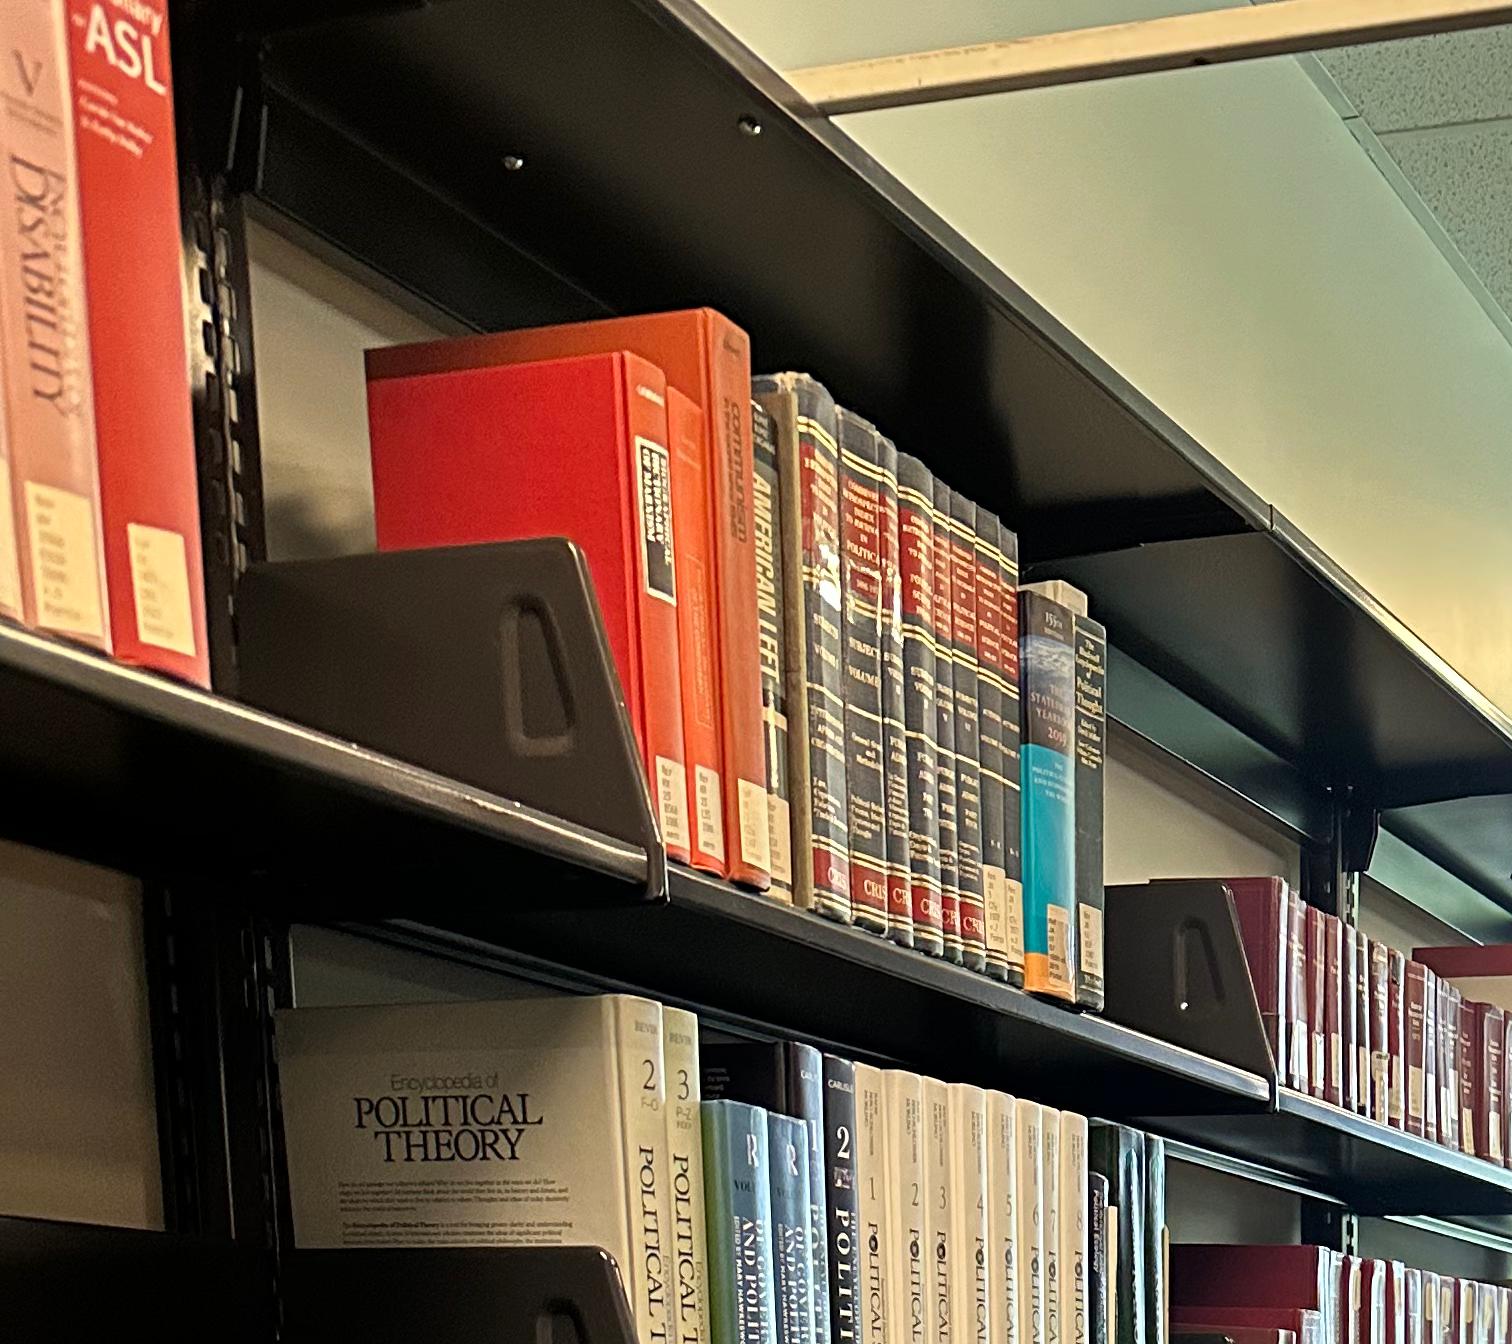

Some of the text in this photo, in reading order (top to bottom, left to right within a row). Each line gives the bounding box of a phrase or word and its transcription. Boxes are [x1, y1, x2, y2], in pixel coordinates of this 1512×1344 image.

[84, 3, 168, 96] ASL
[11, 153, 70, 418] DISABILITY
[753, 471, 780, 683] AMERICAN LEFT
[863, 878, 888, 900] CRIS
[391, 1072, 499, 1094] Encyclopedia of
[642, 1059, 657, 1092] 2
[677, 1069, 690, 1101] 3
[353, 1093, 544, 1129] POLITICAL
[374, 1128, 526, 1162] THEORY
[836, 1125, 851, 1160] 2
[869, 1176, 876, 1201] 1
[911, 1182, 919, 1207] 2
[939, 1185, 947, 1210] 3
[639, 1145, 664, 1322] POLITICAL
[673, 1153, 696, 1322] POLITICAL
[742, 1216, 757, 1267] AND
[784, 1226, 797, 1277] AND
[736, 1260, 744, 1287] MARY
[868, 1222, 883, 1338] POLITICAL
[909, 1228, 923, 1342] POLITICAL
[936, 1230, 949, 1342] POLITICAL
[975, 1236, 986, 1344] POLITICAL
[1004, 1236, 1015, 1343] POLITICAL
